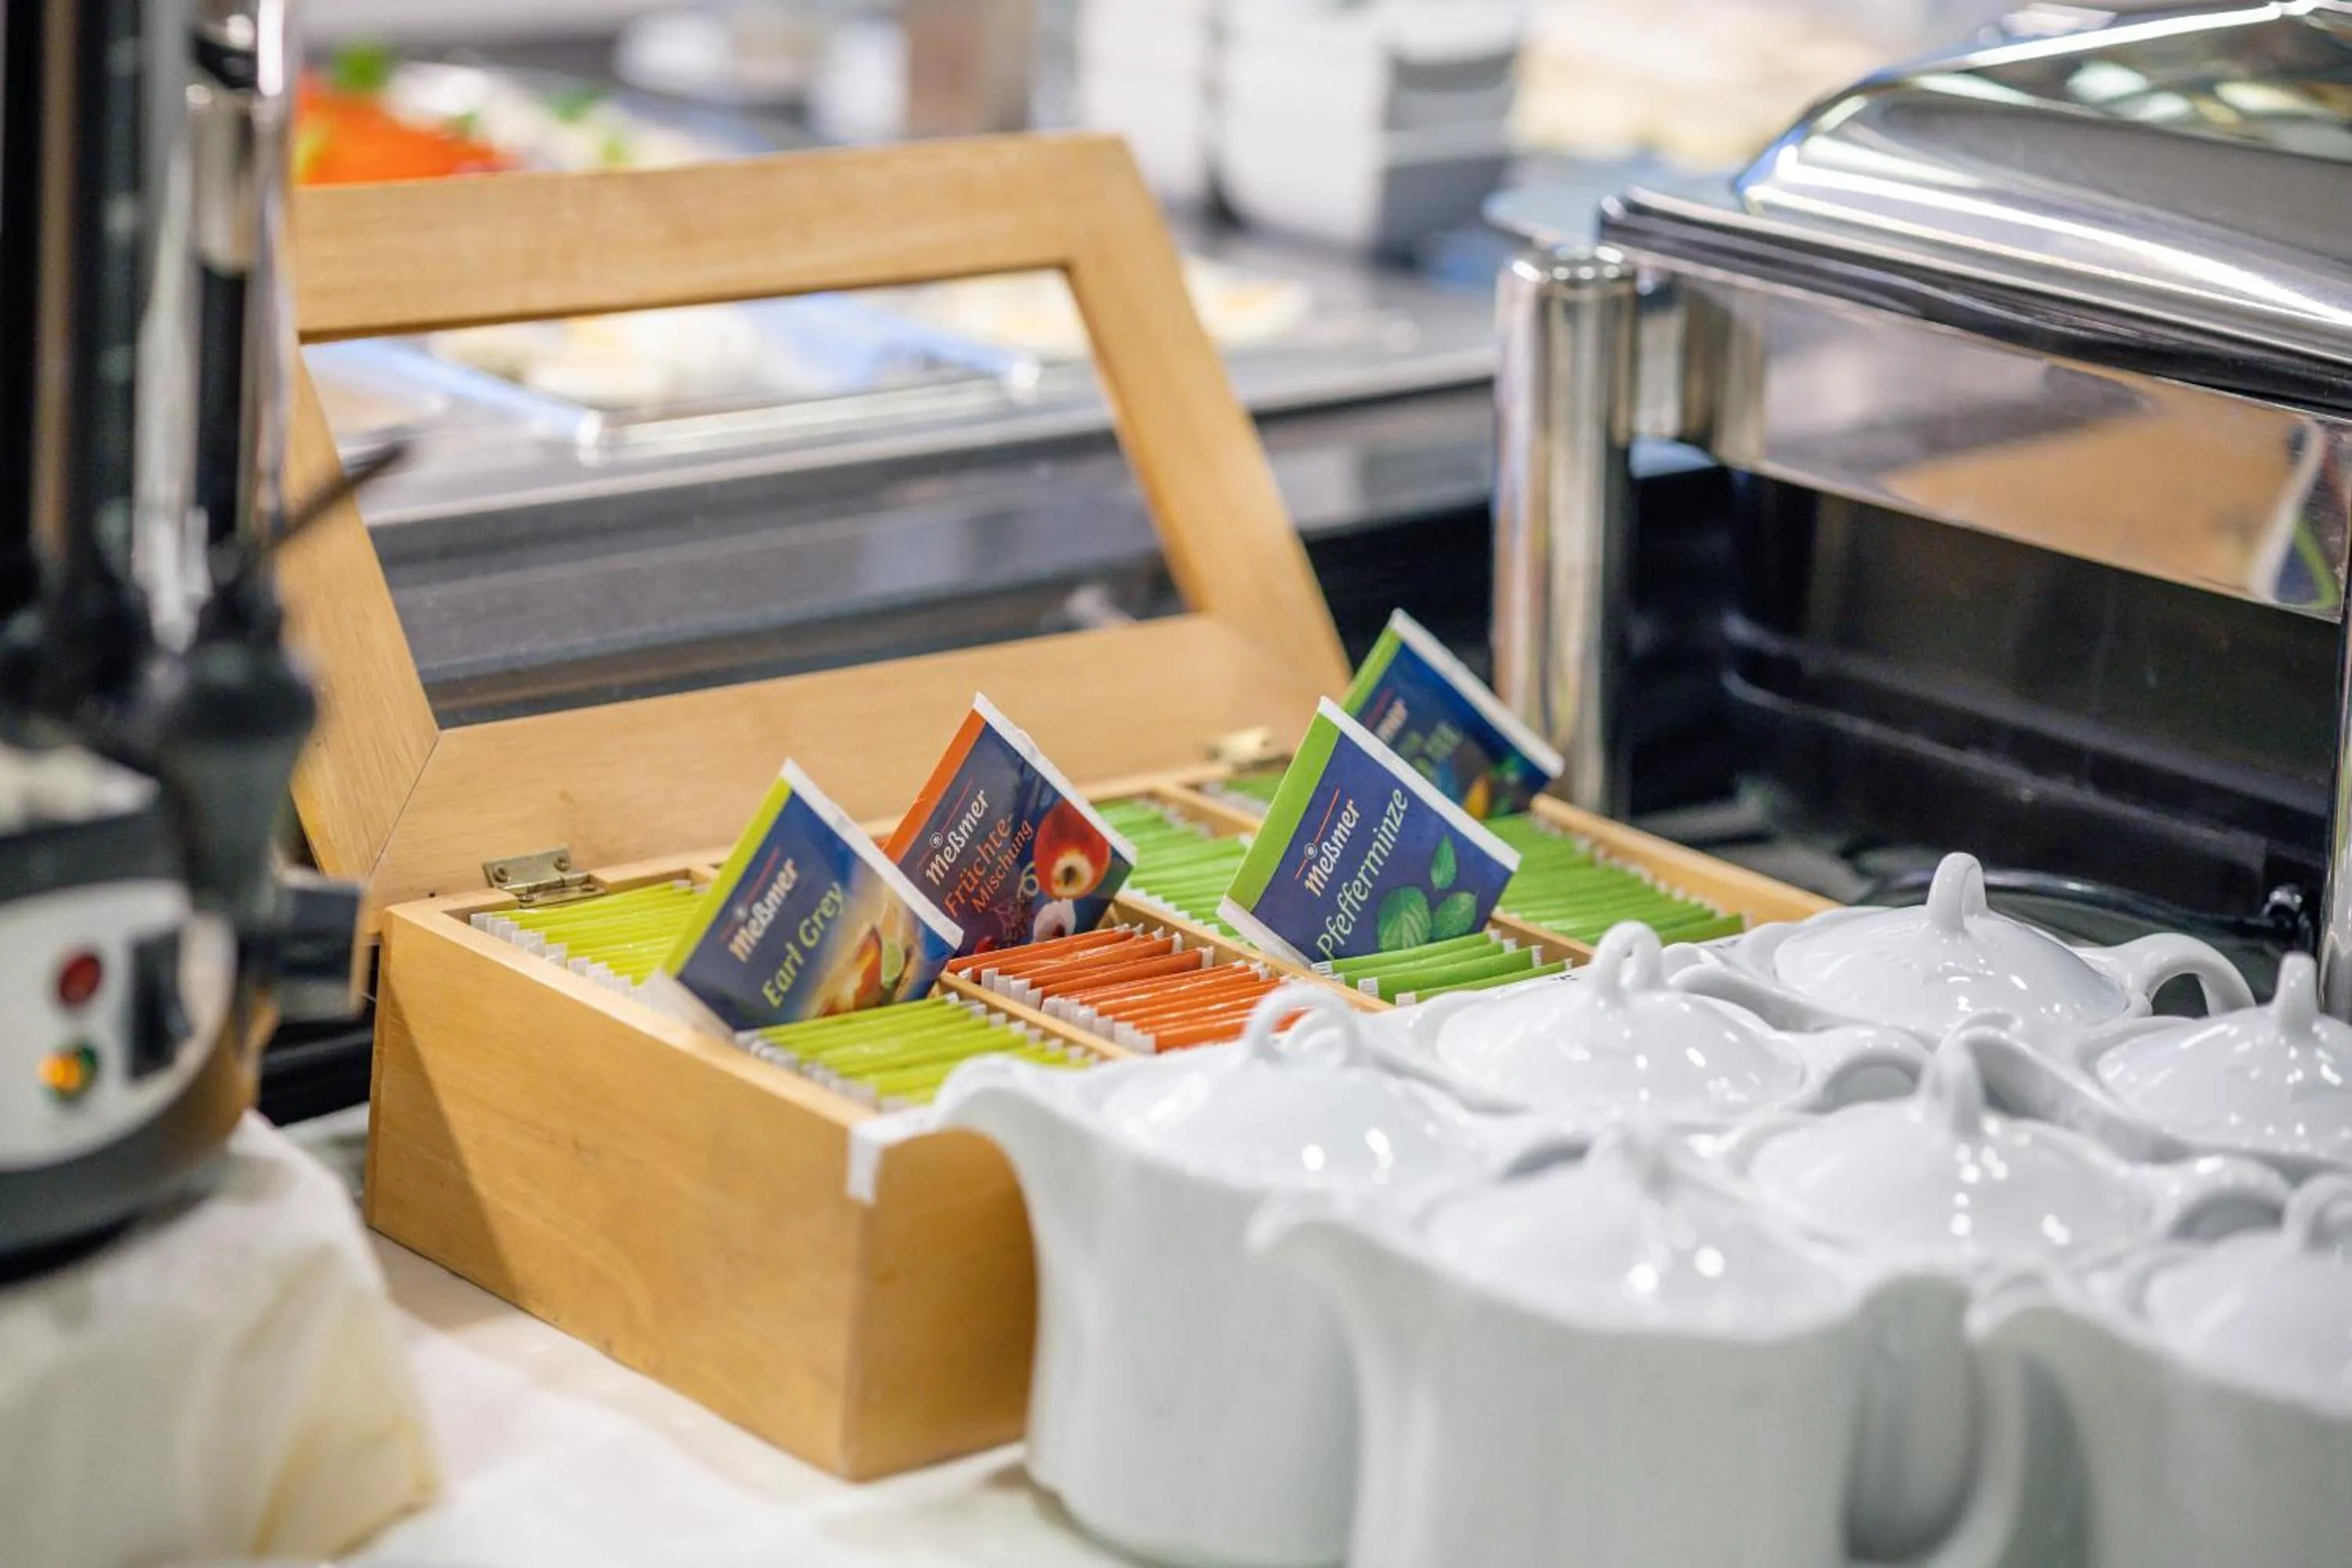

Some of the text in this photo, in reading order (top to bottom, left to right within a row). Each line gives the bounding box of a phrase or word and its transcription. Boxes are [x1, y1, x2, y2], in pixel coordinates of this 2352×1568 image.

[944, 813, 1013, 918] Früchte-
[971, 819, 1033, 913] Mischung
[1316, 788, 1409, 960] Pfefferminze
[761, 881, 846, 1010] Earl Grey
